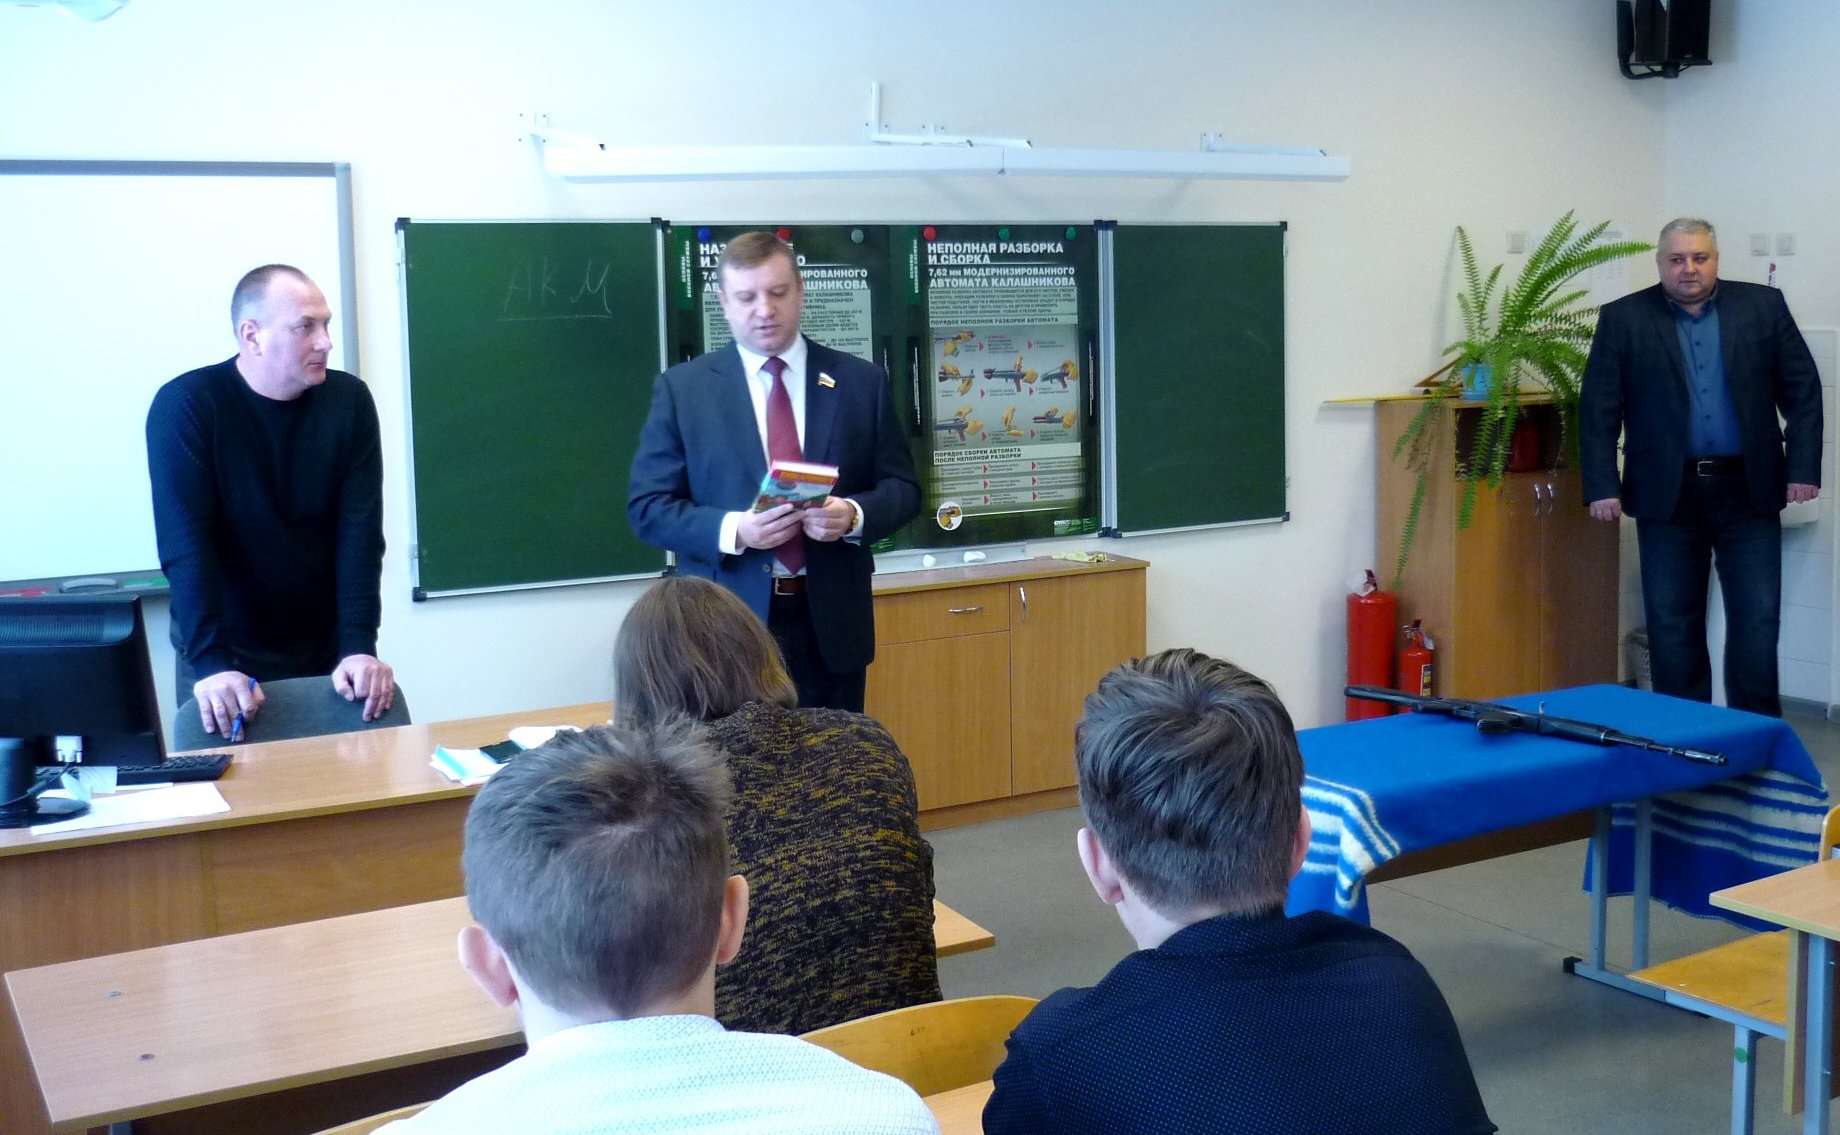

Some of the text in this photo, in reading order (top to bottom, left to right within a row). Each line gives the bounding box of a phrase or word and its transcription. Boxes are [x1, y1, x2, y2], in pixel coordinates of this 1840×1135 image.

[928, 242, 1064, 254] НЕПОЛНАЯ РАЗБОРКА
[928, 254, 991, 264] И СБОРКА
[702, 269, 868, 282] 7,6 ИРОВАННОГО
[928, 268, 948, 278] 7,62
[963, 267, 1075, 278] МОДЕРНИЗИРОВАННОГО
[803, 280, 868, 290] ШНИКОВА
[930, 277, 1076, 288] АВТОМАТА КАЛАШНИКОВА
